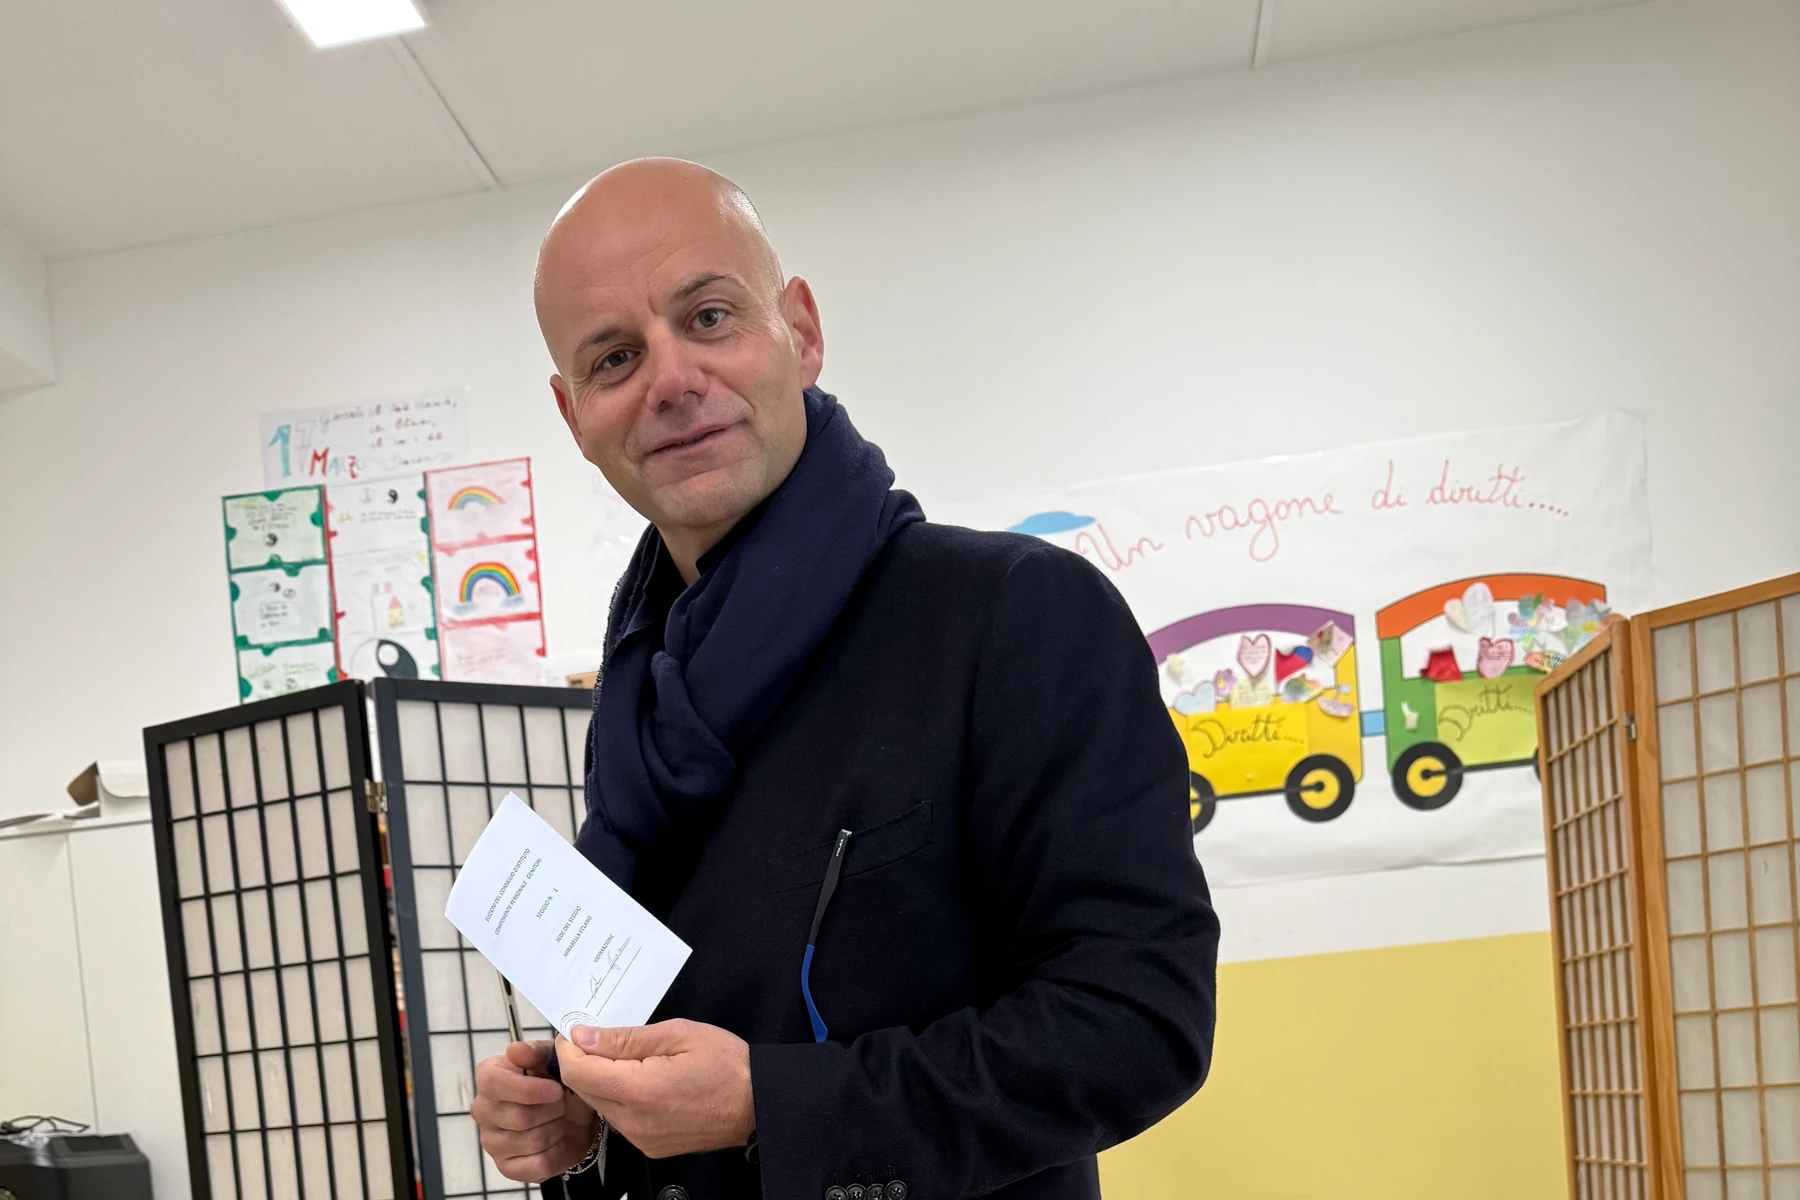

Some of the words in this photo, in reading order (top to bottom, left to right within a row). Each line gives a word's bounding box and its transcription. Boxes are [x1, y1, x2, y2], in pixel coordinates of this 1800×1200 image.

[1075, 523, 1163, 571] Un
[1186, 493, 1342, 562] vagone
[1371, 459, 1407, 509] di
[485, 902, 498, 922] ELEZIONI
[499, 871, 516, 895] CONSIGLIO
[513, 848, 530, 872] D'ISTITUTO
[495, 904, 513, 935] COMPONENTE
[510, 880, 528, 905] PERSONALE
[526, 858, 542, 879] GENITORI
[536, 900, 550, 919] SEGGIO
[556, 931, 566, 943] SEDE
[568, 905, 581, 923] SEGGIO
[563, 932, 582, 957] MIRABELLA
[580, 915, 593, 934] ECLANO
